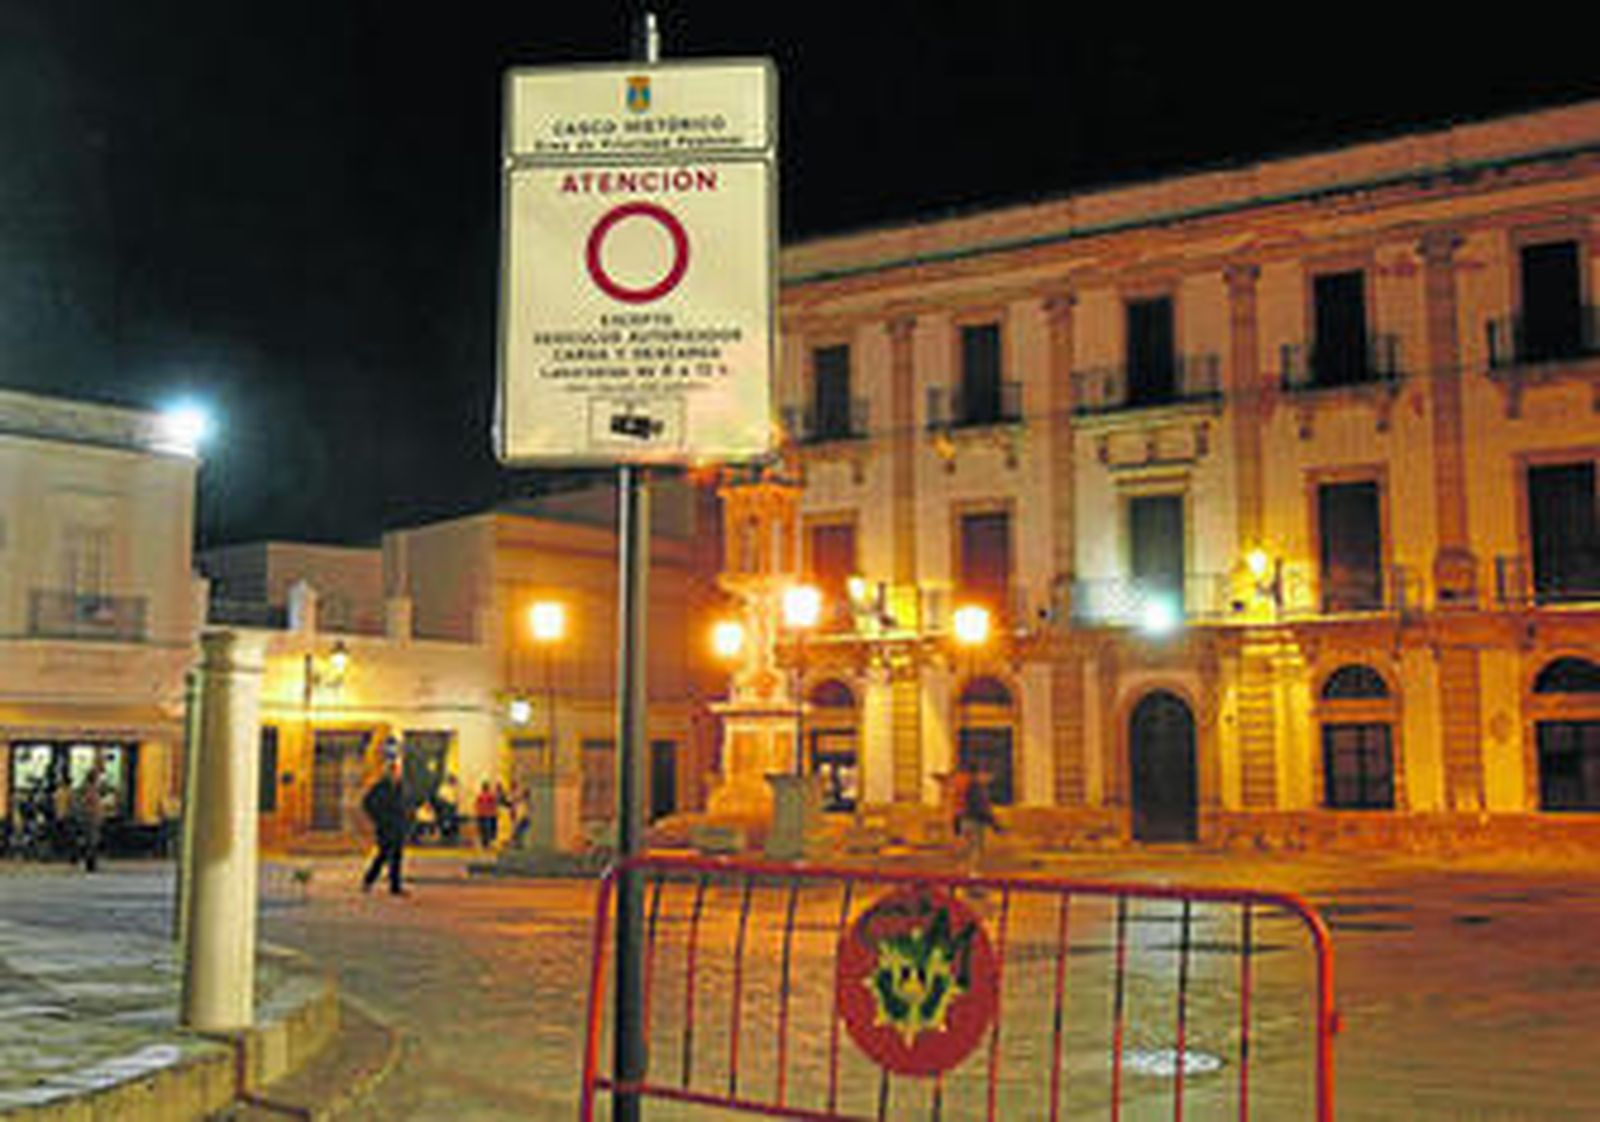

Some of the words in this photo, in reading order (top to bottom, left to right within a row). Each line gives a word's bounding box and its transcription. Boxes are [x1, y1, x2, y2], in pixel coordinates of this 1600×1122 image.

[553, 118, 617, 136] CASCO
[553, 348, 609, 360] CARGA
[615, 348, 627, 359] Y
[632, 346, 721, 360] DESCARGA
